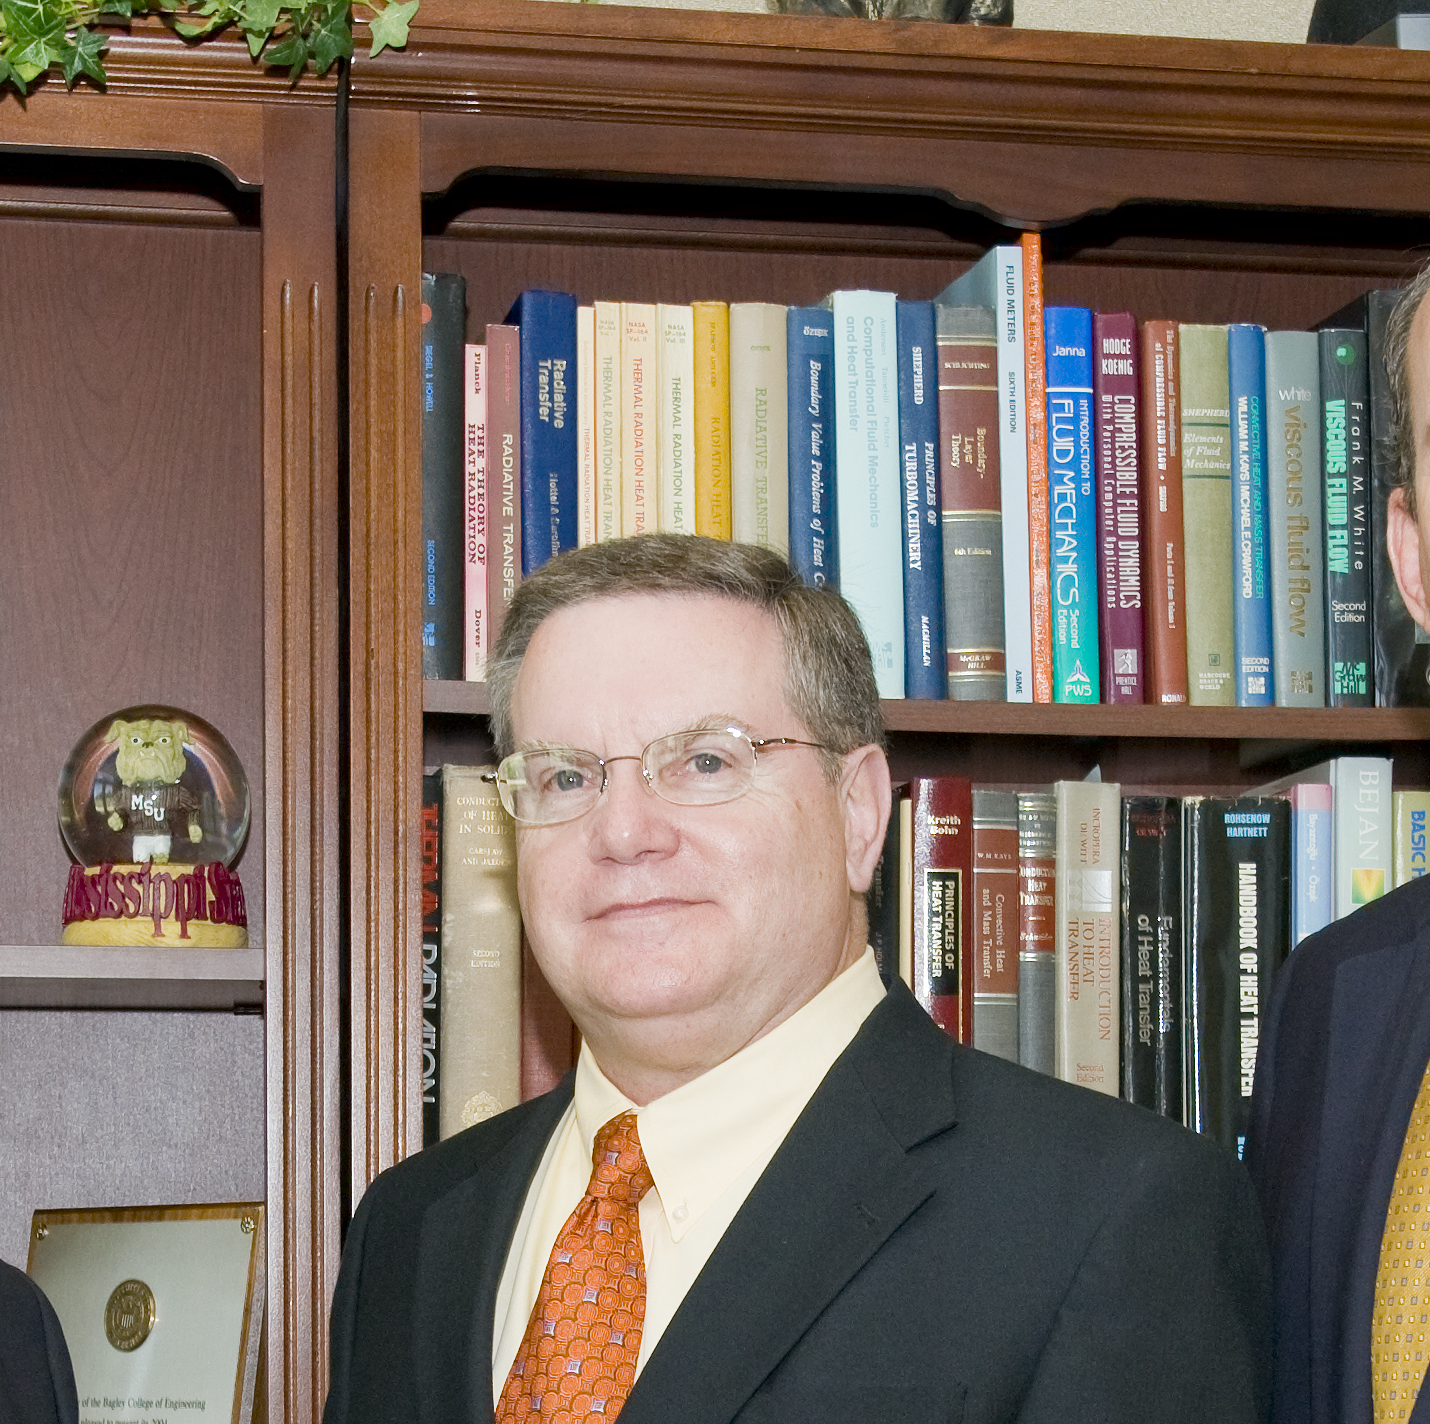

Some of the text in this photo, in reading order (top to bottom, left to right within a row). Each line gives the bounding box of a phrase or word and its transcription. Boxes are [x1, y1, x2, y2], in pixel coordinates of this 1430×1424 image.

[1005, 265, 1016, 344] FLUID METERS
[846, 315, 860, 433] and Heat Transfer
[1052, 345, 1086, 357] Janna
[1101, 359, 1134, 376] KOENIG
[1102, 338, 1131, 355] HODGE
[538, 359, 553, 423] Transfer
[553, 358, 567, 429] Radiative
[862, 315, 881, 528] Computational Fluid Mechanics
[1008, 371, 1017, 434] SIXTH EDITION
[1154, 342, 1167, 470] of COMPRESSIBLE FLUID FLOW
[1182, 408, 1230, 417] SHEPHERD
[672, 376, 684, 532] THERMAL RADIATION HEAT
[950, 433, 961, 468] Theory
[964, 437, 975, 464] Layer
[1079, 399, 1091, 496] INTRODUCTION TO
[1183, 433, 1224, 443] Elements
[1183, 446, 1221, 456] of Fluid
[1183, 459, 1231, 470] Mechanics
[1237, 395, 1250, 481] WILLIAM M. KAYS
[467, 423, 477, 565] HEAT RADIATION
[477, 423, 486, 565] THE THEORY OF
[711, 416, 722, 525] RADIATION HEAT
[924, 441, 937, 526] PRINCIPLES OF
[1052, 399, 1079, 606] FLUID MECHANICS
[1102, 394, 1117, 609] With Personal Computer Applications
[1114, 395, 1141, 609] COMPRESSIBLE FLUID DYNAMICS
[1325, 398, 1349, 574] VISCOUS FLUID FLOW
[1351, 402, 1366, 571] Frank M. White
[904, 442, 922, 571] TURBOMACHINERY
[1284, 404, 1311, 638] viscous fluid flow
[1057, 609, 1067, 645] Edition
[1070, 609, 1081, 649] Second
[1331, 600, 1366, 612] Second
[1334, 612, 1366, 623] Edition
[1015, 669, 1023, 694] ASME
[1065, 684, 1093, 697] PWS
[1241, 657, 1270, 665] SECOND
[1242, 665, 1269, 673] EDITION
[131, 794, 165, 821] MSU
[927, 814, 961, 826] Kreith
[930, 825, 959, 836] Bohn
[1092, 807, 1101, 865] INCROPERA
[1224, 813, 1271, 824] ROHSENOW
[1226, 826, 1269, 838] HARTNETT
[1354, 769, 1379, 862] BEJAN
[932, 880, 943, 978] HEAT TRANSFER
[945, 880, 956, 970] PRINCIPLES OF
[982, 888, 993, 979] and Mass Transfer
[995, 893, 1005, 973] Convective Heat
[1238, 863, 1258, 950] HANDBOOK
[1068, 918, 1080, 1001] TRANSFER
[1082, 918, 1095, 986] TO HEAT
[1098, 918, 1112, 1041] INTRODUCTION
[1137, 913, 1154, 1047] of Heat Transfer
[1239, 952, 1258, 974] OF
[1239, 975, 1259, 1015] HEAT
[1076, 1062, 1104, 1072] Second
[1076, 1073, 1104, 1083] Edition
[81, 1397, 206, 1411] of the Bagley College of Engineering
